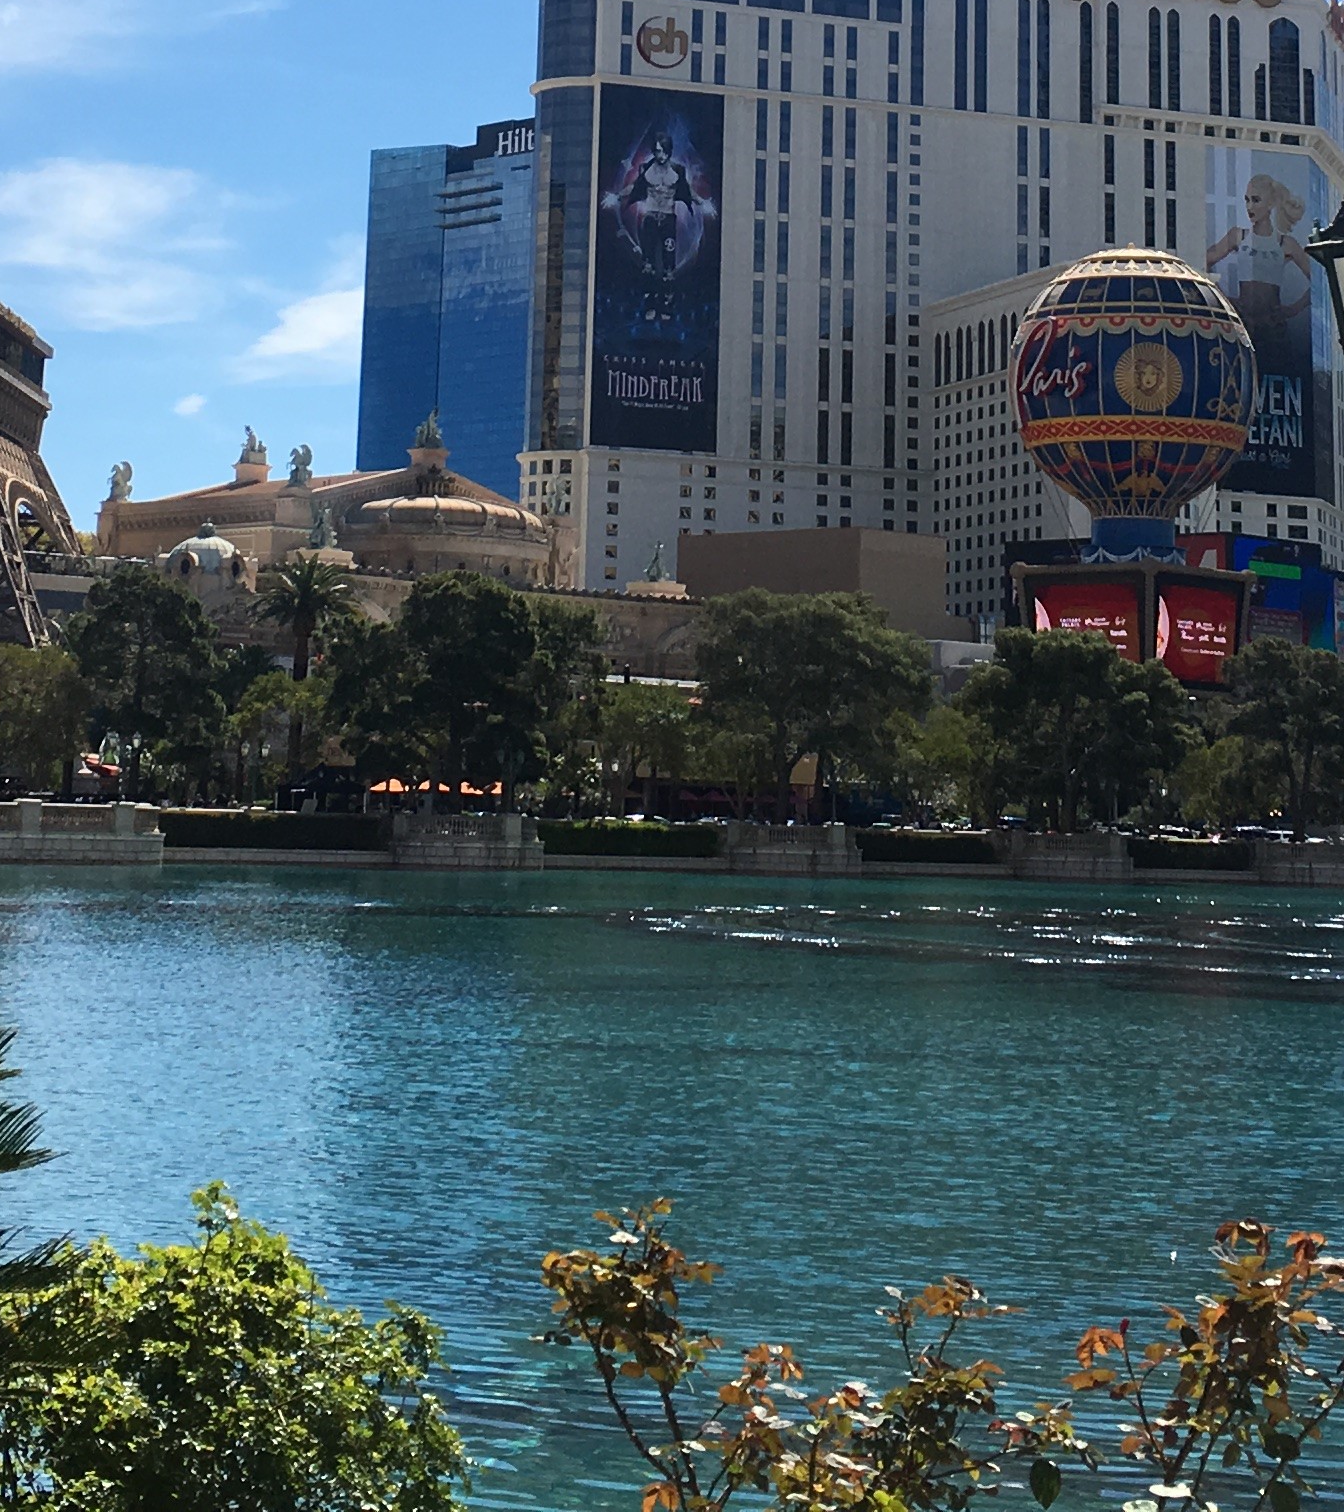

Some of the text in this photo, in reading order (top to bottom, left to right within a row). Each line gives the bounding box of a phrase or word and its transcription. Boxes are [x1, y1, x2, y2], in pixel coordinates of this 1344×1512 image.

[641, 16, 689, 63] ph
[606, 369, 704, 403] MINDFREAK
[1015, 316, 1093, 428] Paris
